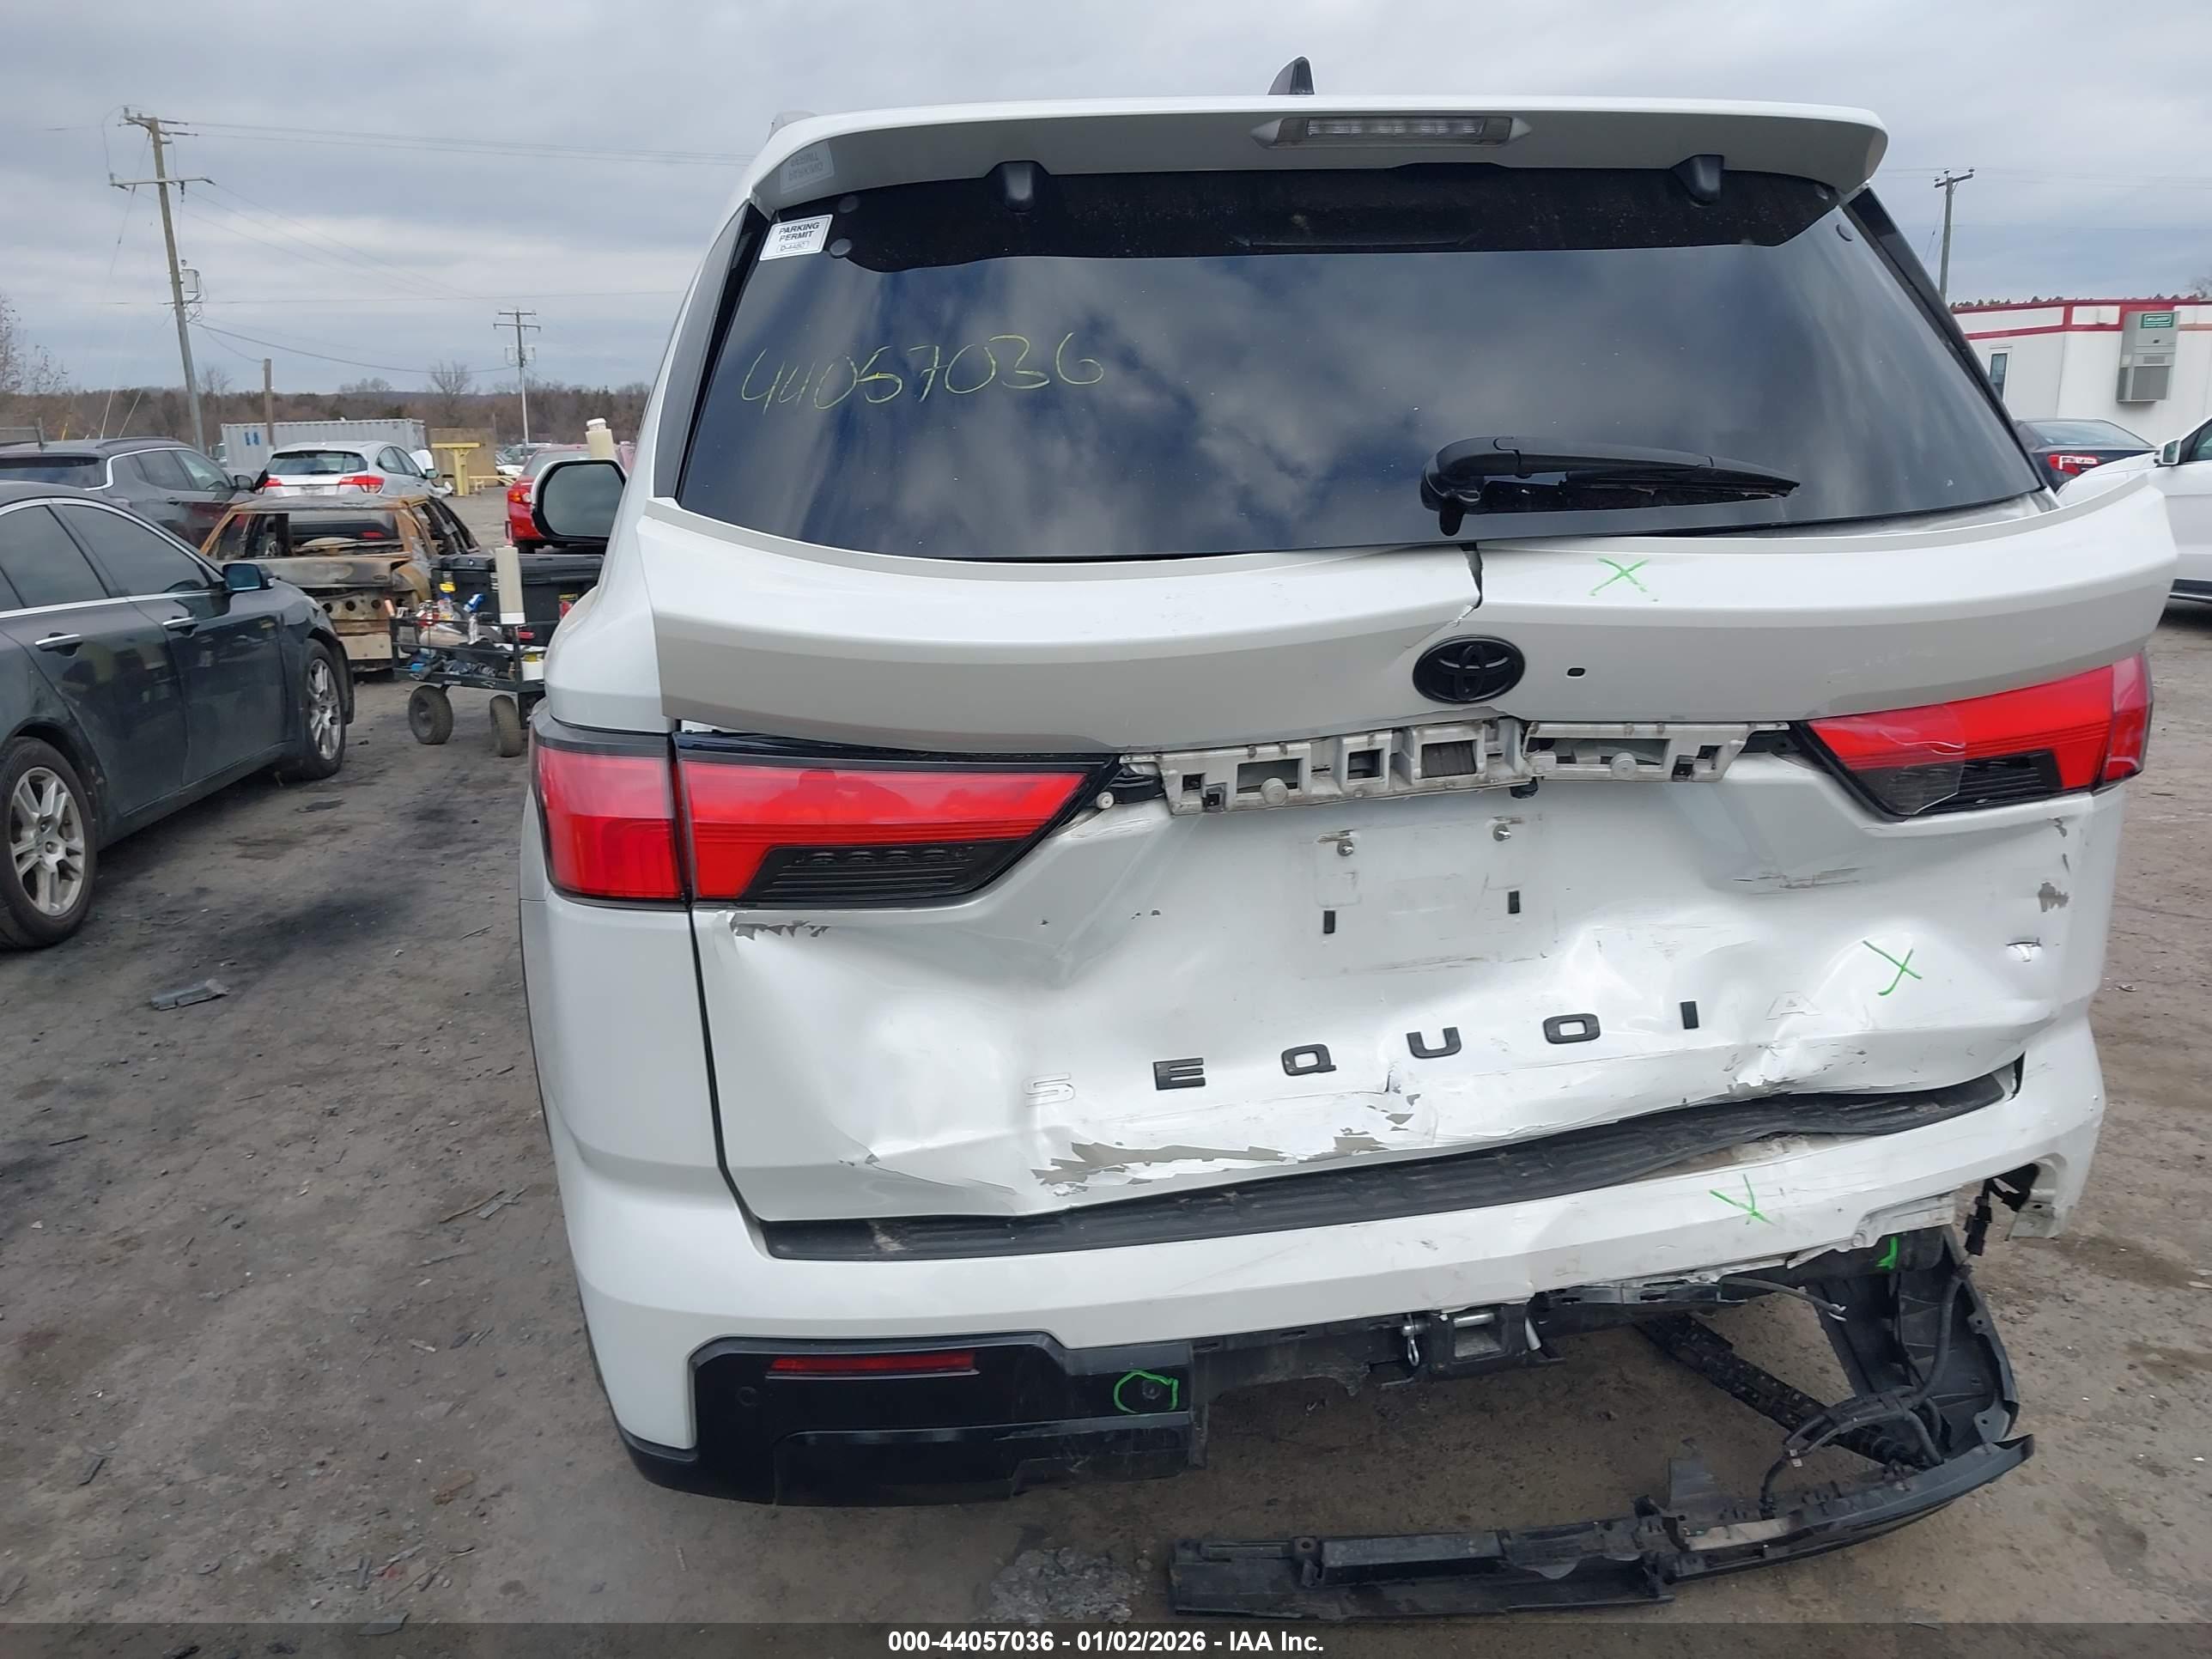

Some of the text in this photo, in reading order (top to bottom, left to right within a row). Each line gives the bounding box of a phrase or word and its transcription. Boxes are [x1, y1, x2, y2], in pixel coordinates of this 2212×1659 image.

[779, 222, 820, 234] PARKING
[779, 231, 815, 241] PERMIT
[740, 332, 1104, 415] 44057036
